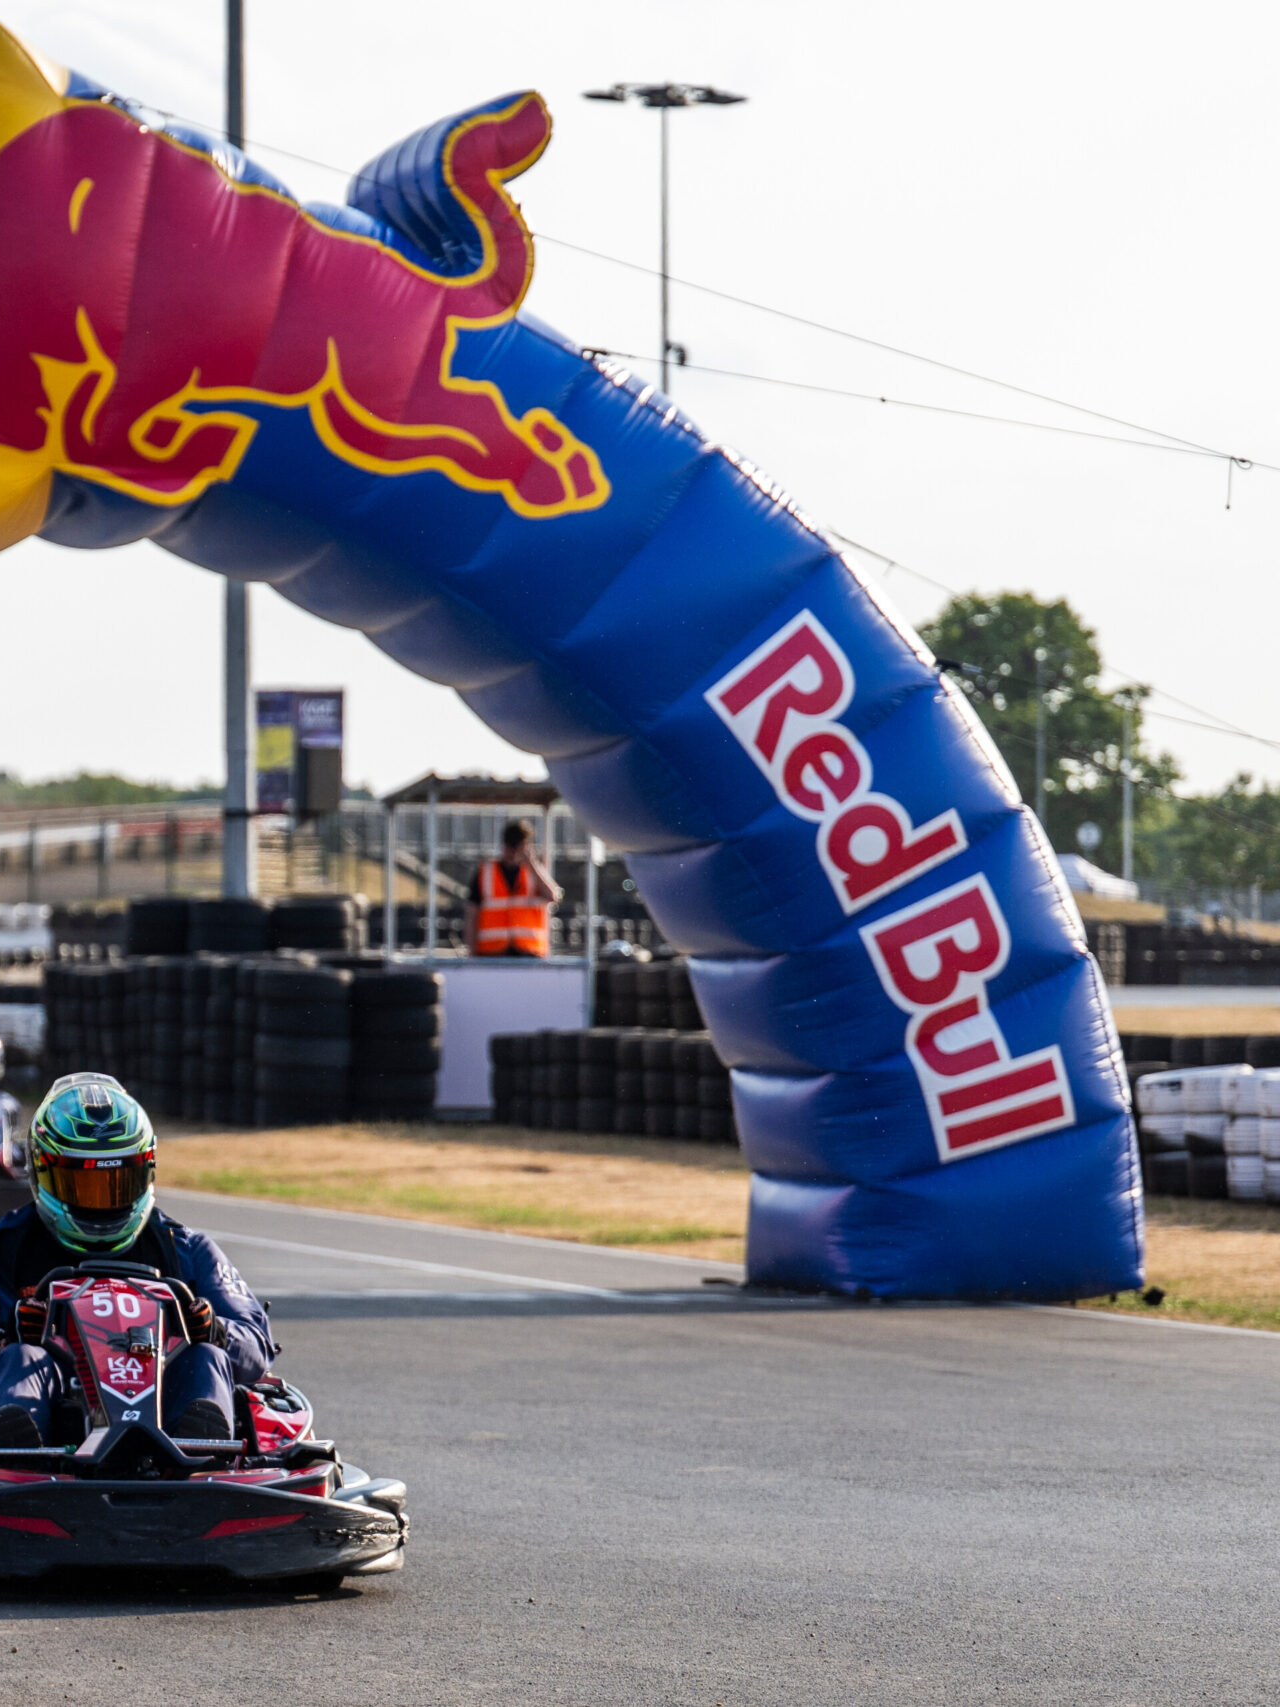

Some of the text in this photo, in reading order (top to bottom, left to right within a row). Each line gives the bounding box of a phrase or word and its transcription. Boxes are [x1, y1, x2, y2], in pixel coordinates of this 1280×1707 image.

[707, 611, 1072, 1162] Red Bull
[92, 1292, 141, 1319] 50
